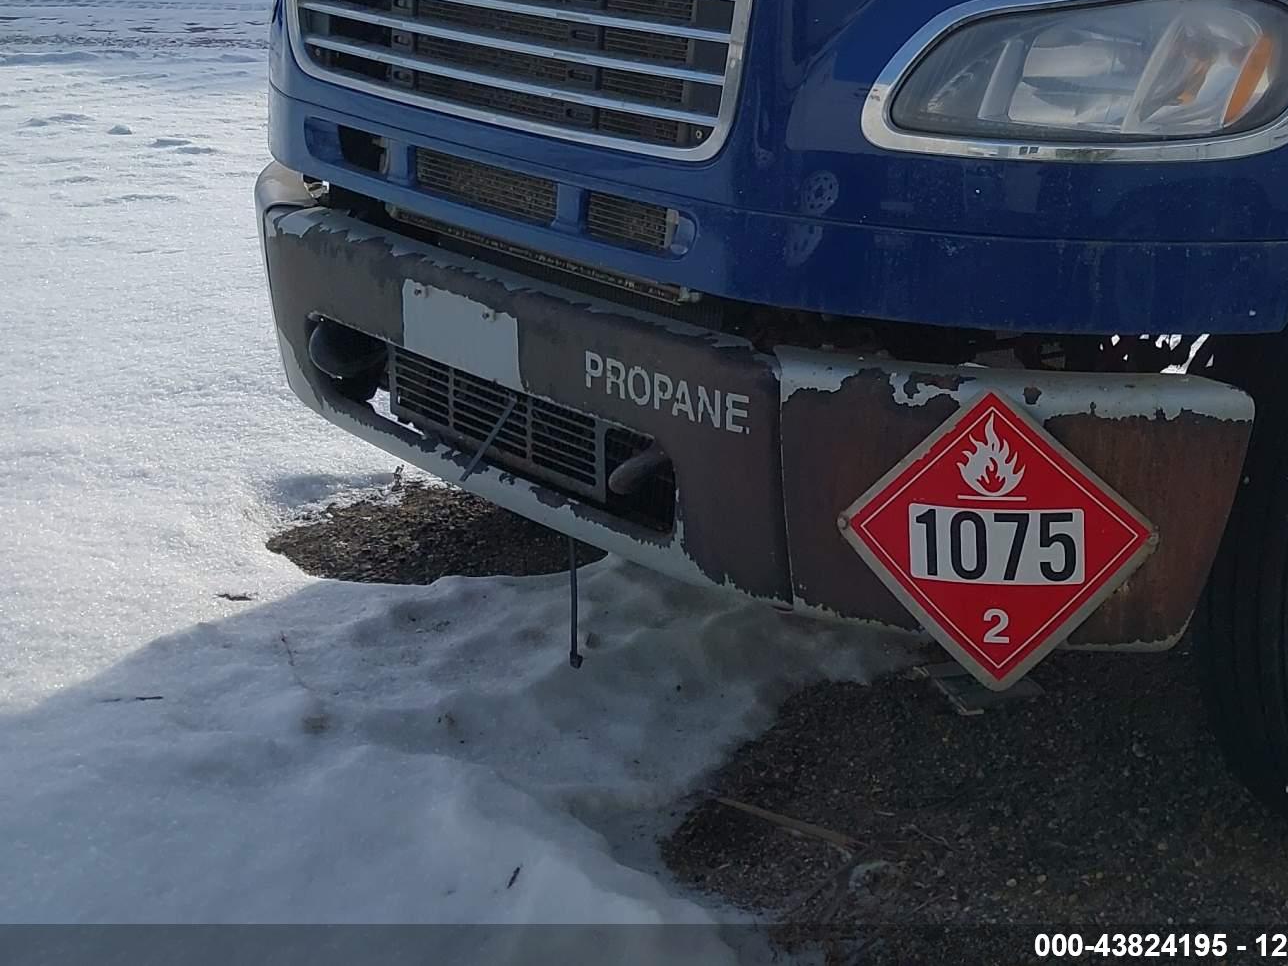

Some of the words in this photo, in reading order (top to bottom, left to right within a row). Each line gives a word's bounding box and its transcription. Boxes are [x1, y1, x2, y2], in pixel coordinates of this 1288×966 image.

[585, 350, 750, 434] PROPANE
[915, 508, 1077, 582] 1075
[983, 608, 1010, 644] 2
